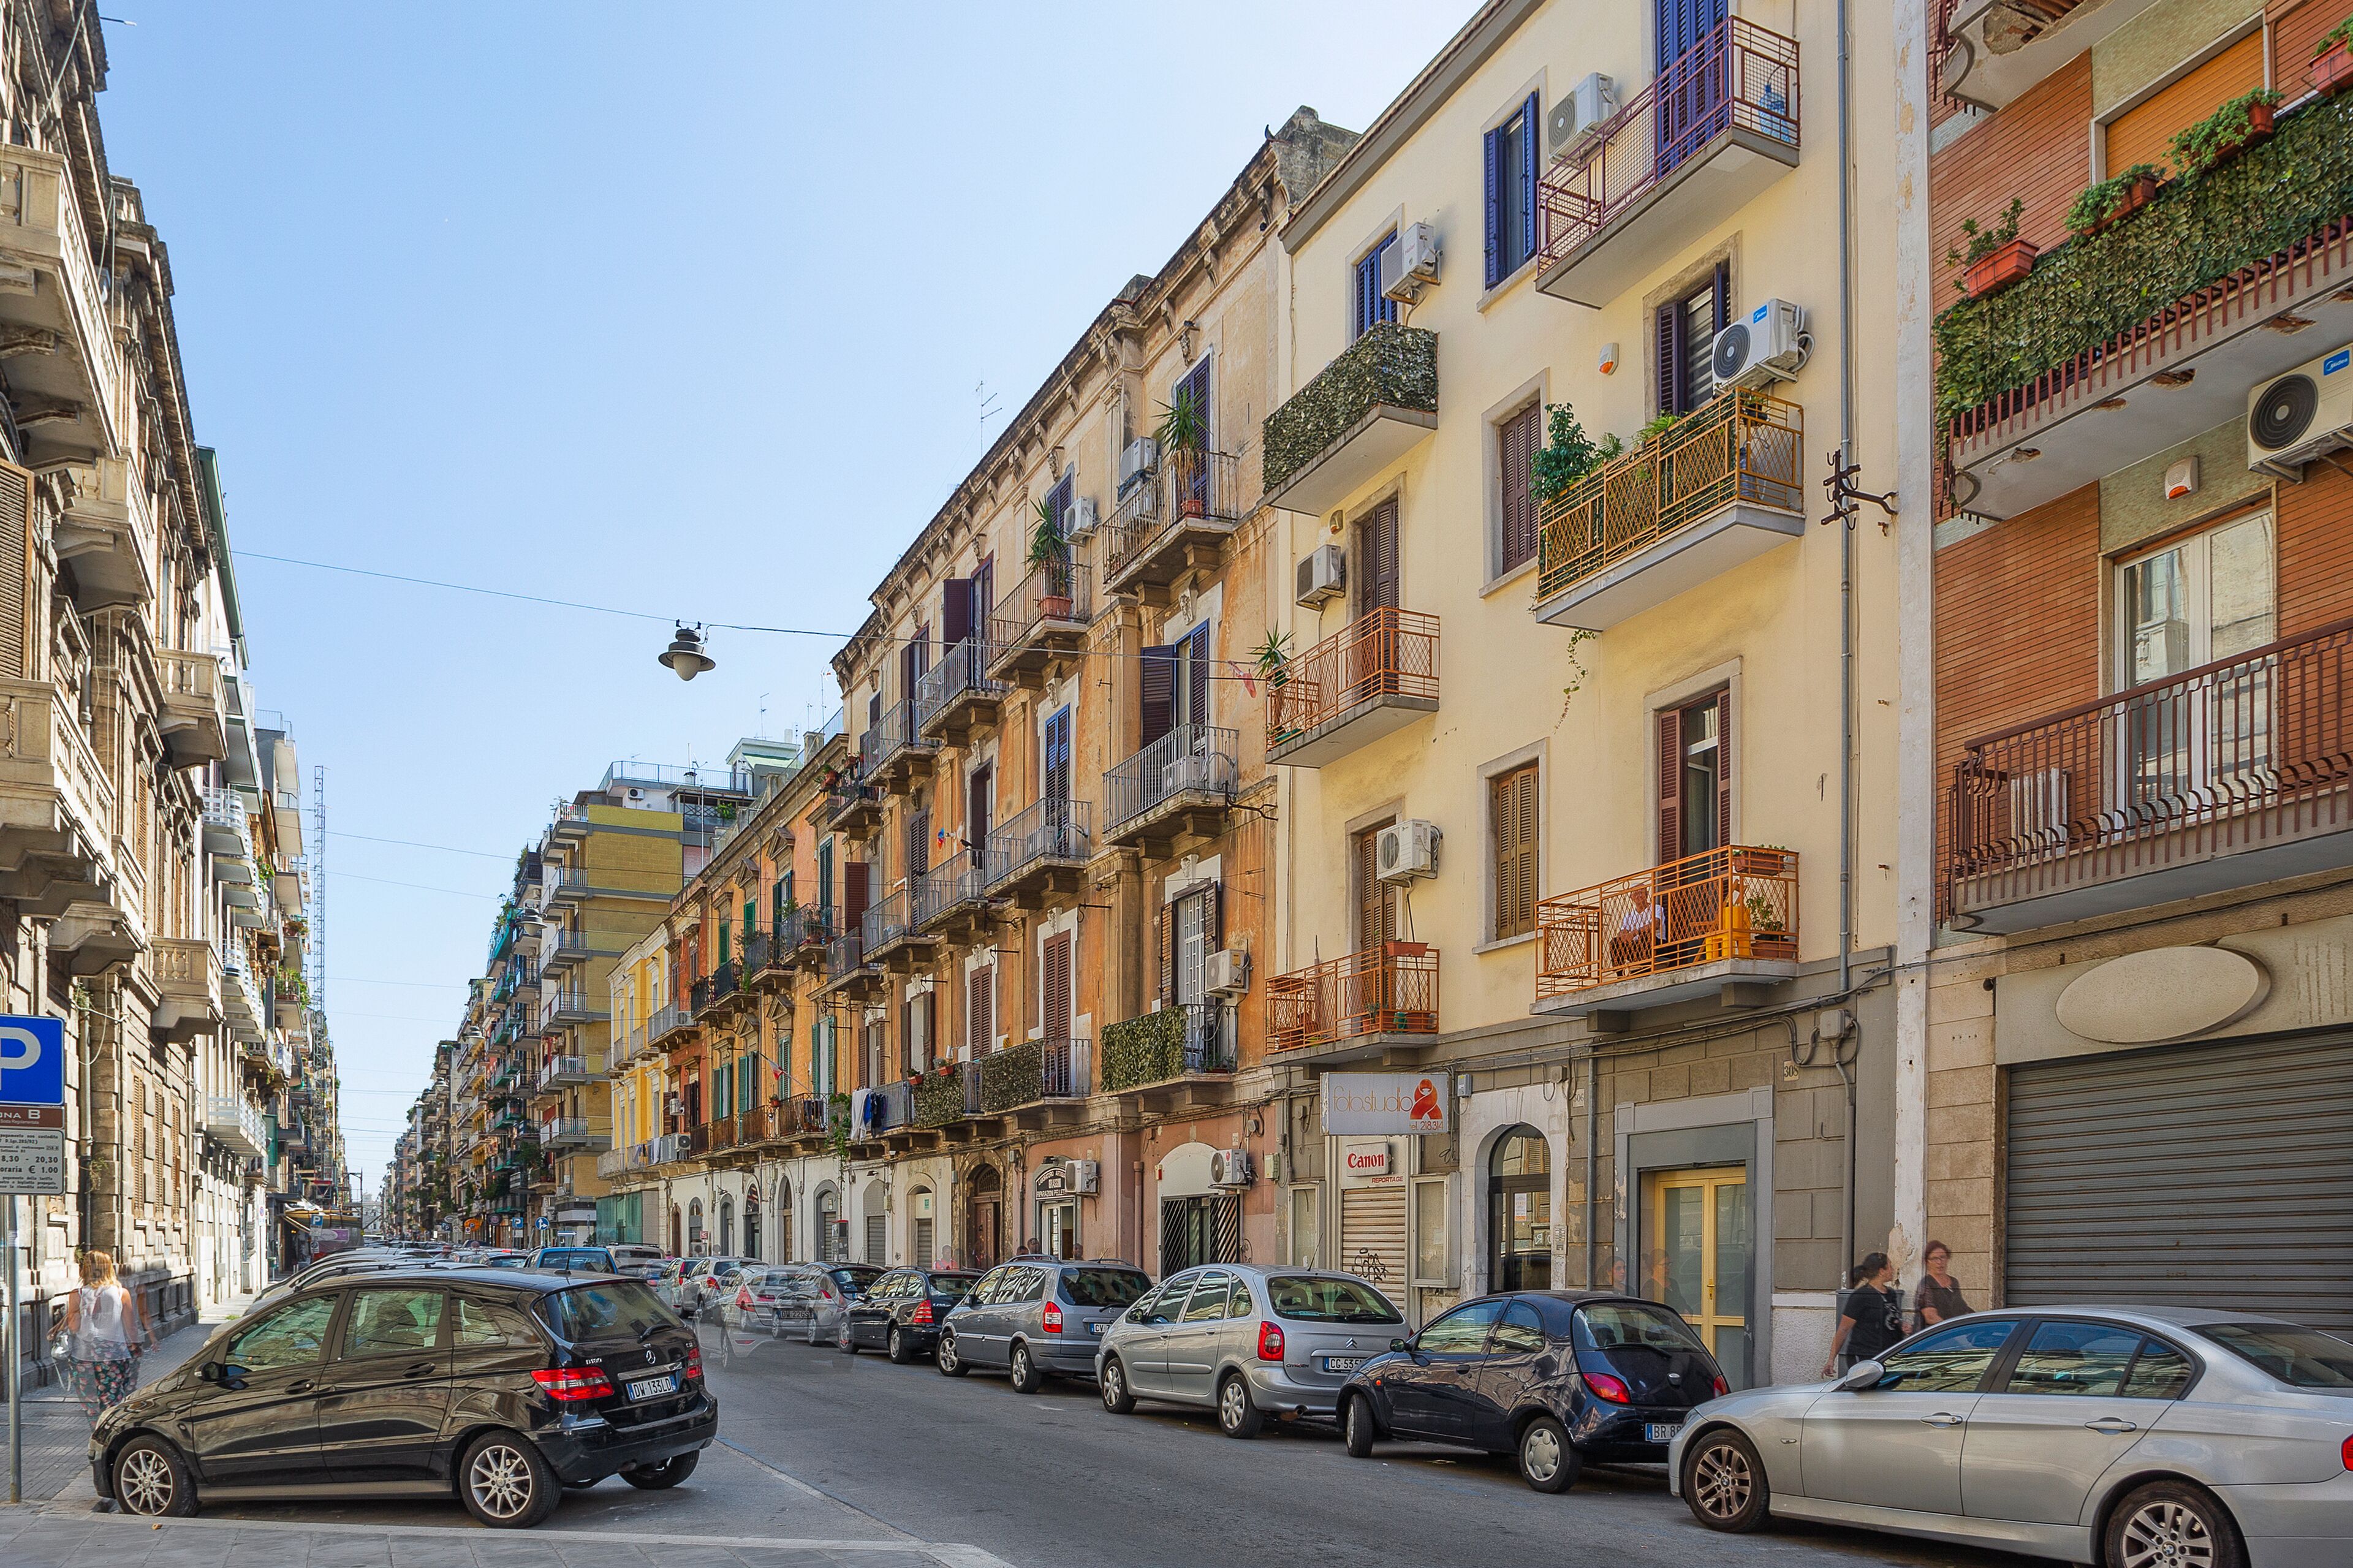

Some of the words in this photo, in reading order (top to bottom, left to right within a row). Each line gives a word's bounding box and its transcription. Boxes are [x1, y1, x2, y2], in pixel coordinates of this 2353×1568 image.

[1784, 1065, 1798, 1077] 308
[1333, 1086, 1413, 1112] fotostudio
[28, 1109, 40, 1119] B
[1347, 1153, 1384, 1168] Canon
[28, 1165, 36, 1174] €
[648, 1378, 672, 1395] 133LD
